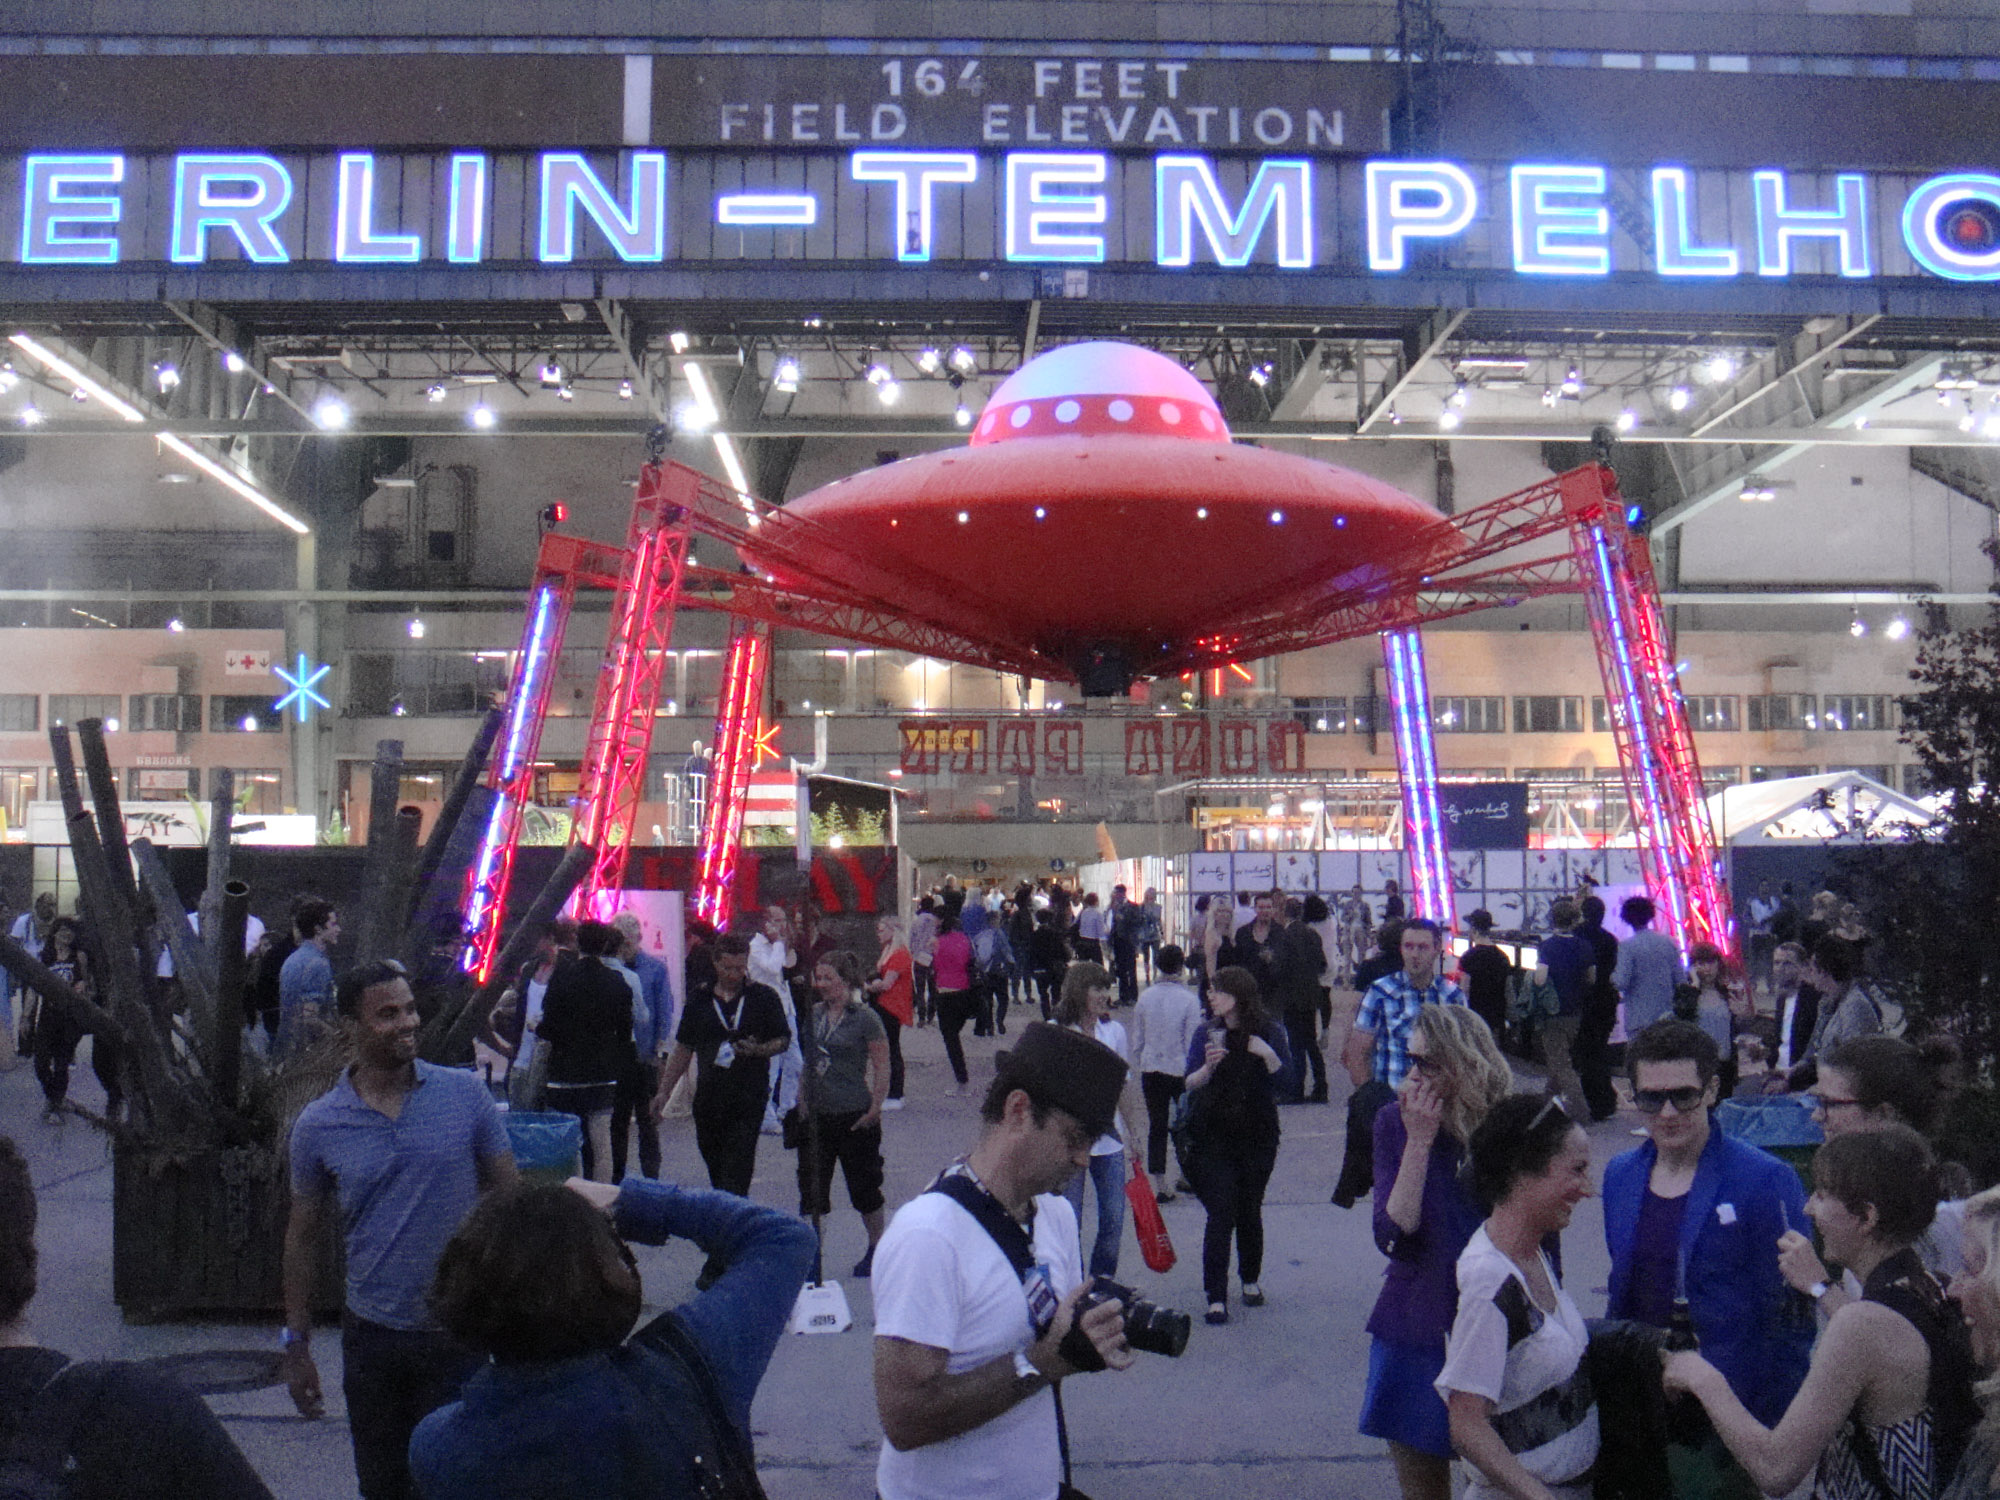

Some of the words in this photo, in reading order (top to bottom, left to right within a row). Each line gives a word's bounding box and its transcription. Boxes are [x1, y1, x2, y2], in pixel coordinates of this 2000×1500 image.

[881, 60, 984, 97] 164
[1033, 61, 1189, 99] FEET
[721, 103, 908, 141] FIELD
[982, 104, 1344, 146] ELEVATION
